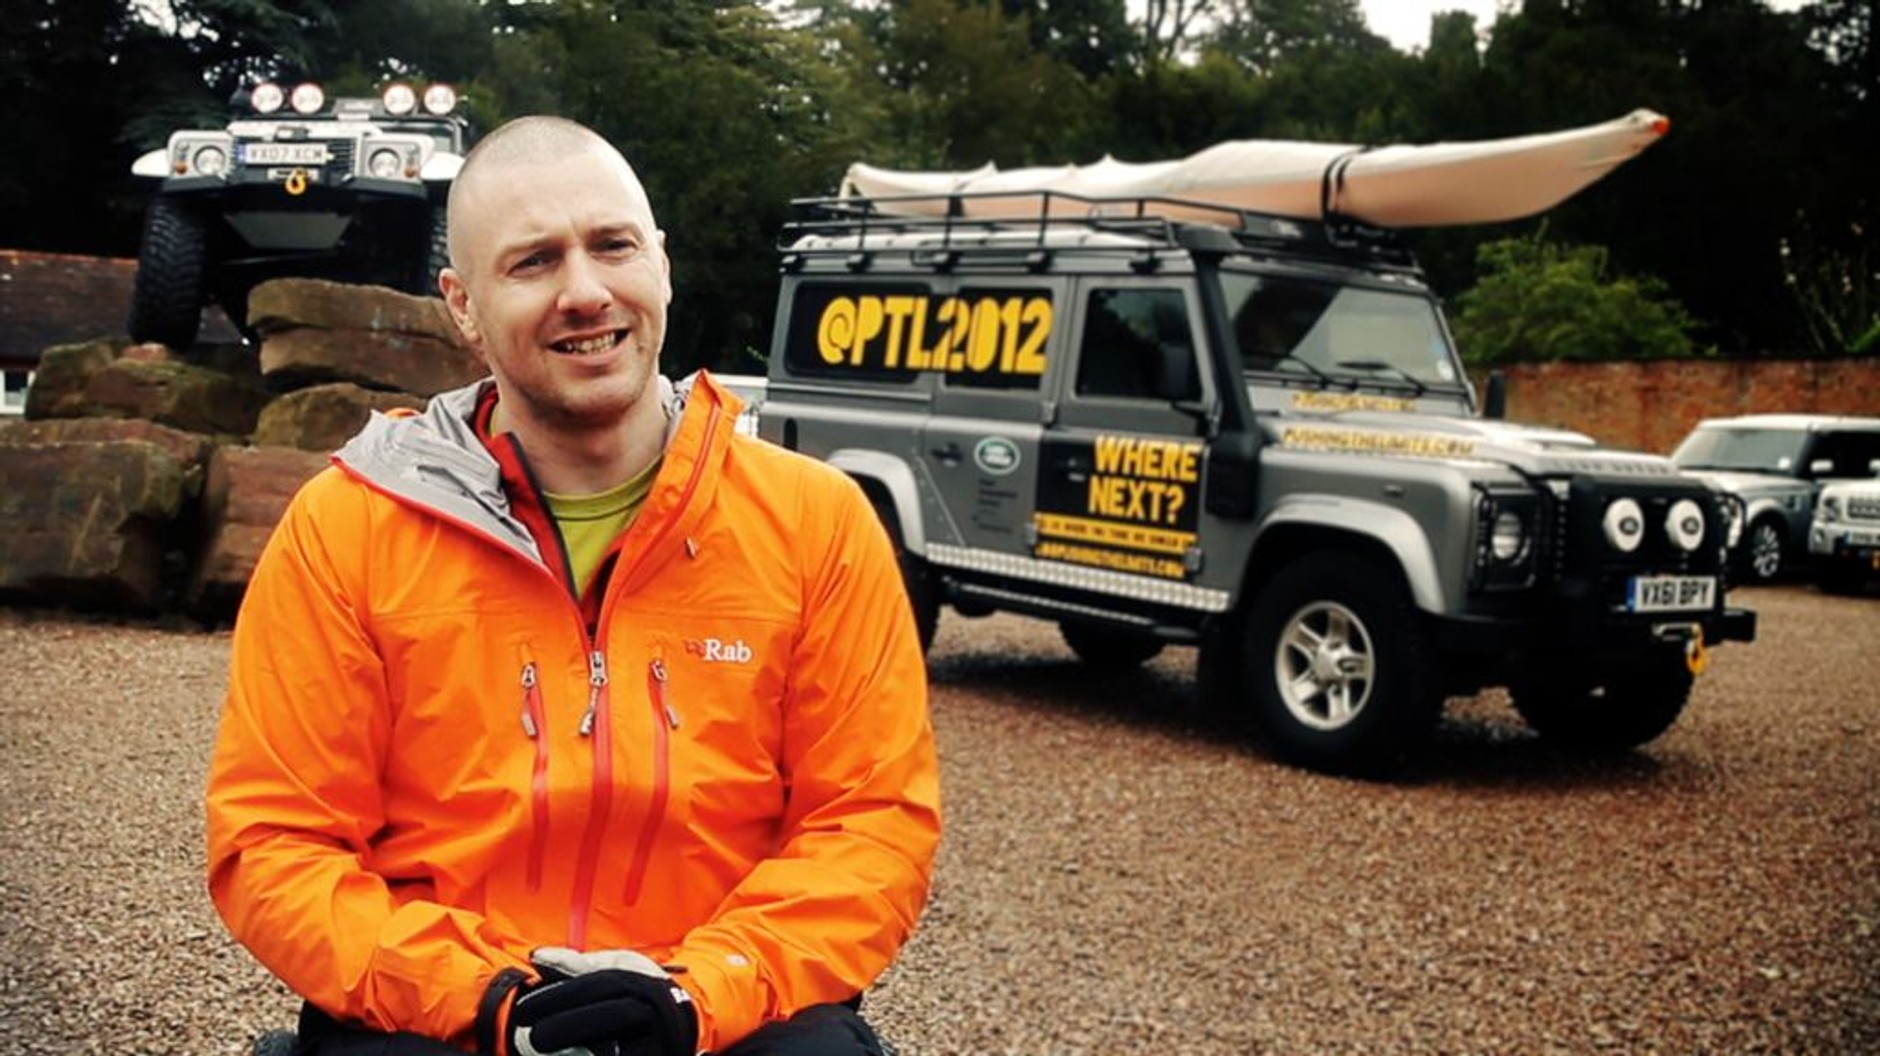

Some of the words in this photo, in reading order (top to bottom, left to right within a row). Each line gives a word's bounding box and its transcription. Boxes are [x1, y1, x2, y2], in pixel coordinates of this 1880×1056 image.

[818, 296, 1054, 373] @PTL2012
[1095, 436, 1201, 482] WHERE
[1088, 475, 1184, 523] NEXT?
[704, 638, 751, 663] Rab
